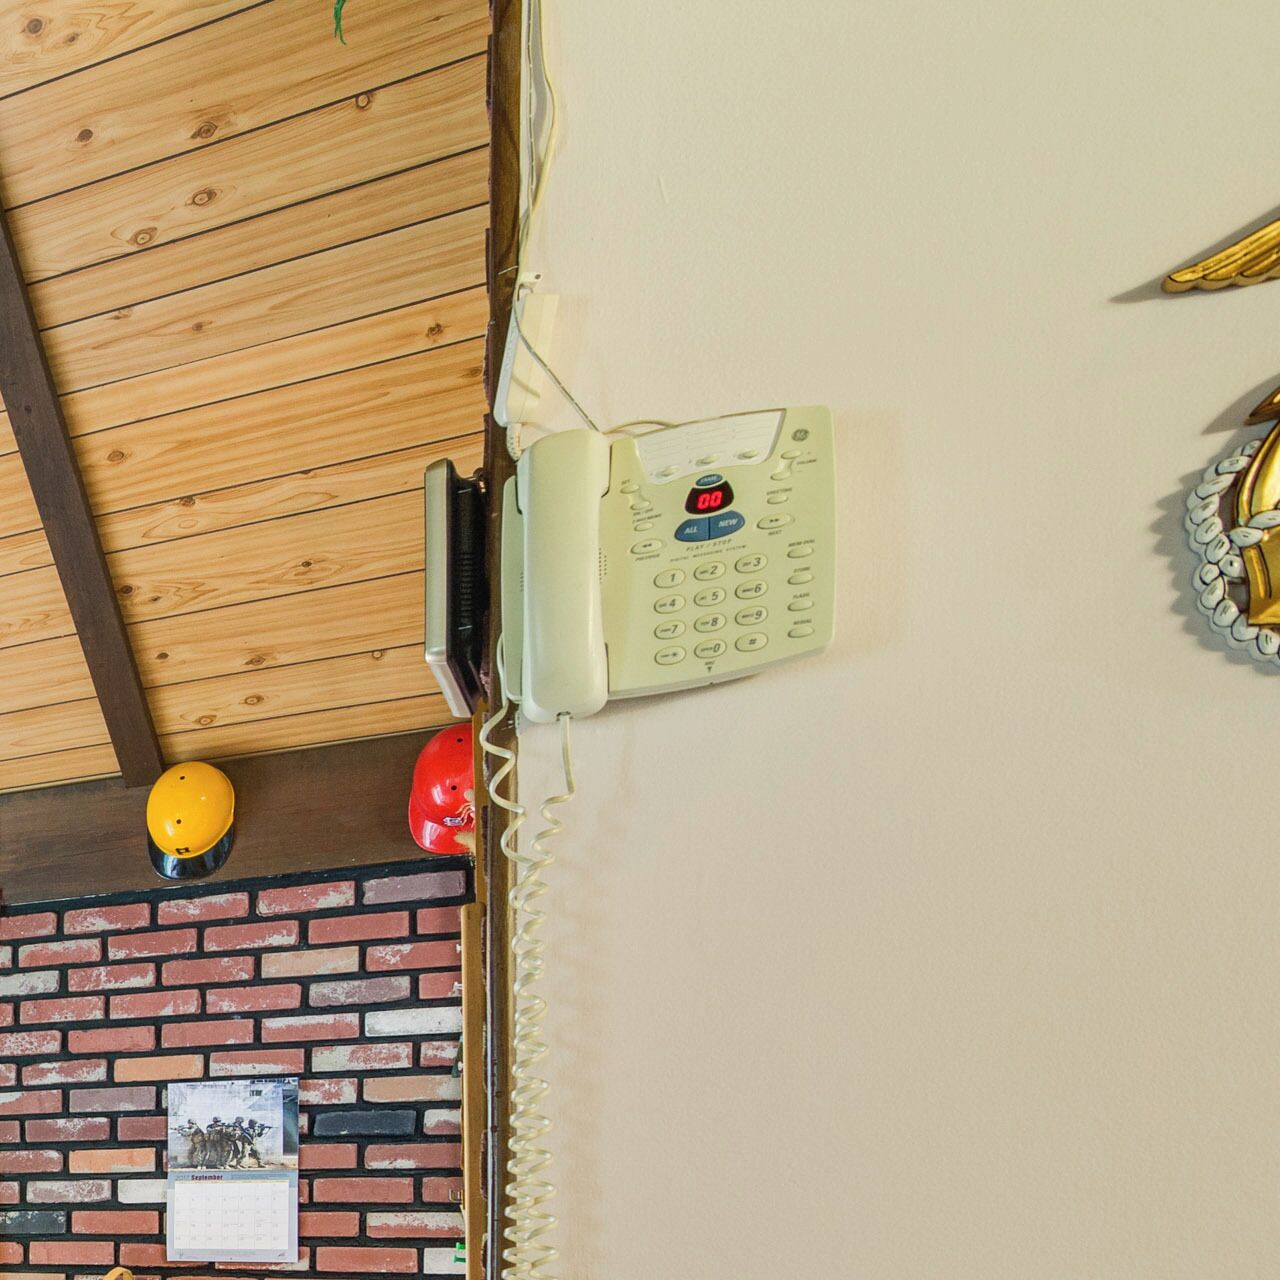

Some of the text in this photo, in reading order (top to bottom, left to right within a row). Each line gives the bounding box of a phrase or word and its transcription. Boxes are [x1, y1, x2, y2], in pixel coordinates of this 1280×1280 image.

[697, 490, 723, 510] 00
[718, 517, 739, 528] NEW
[684, 526, 698, 534] ALL
[686, 543, 704, 551] PLAY
[712, 538, 733, 547] STOP
[753, 557, 761, 567] 3
[710, 565, 718, 575] 2
[670, 573, 676, 582] 1
[754, 583, 762, 593] 6
[711, 591, 719, 601] 5
[669, 598, 676, 607] 4
[755, 610, 763, 620] 9
[710, 617, 719, 627] 8
[671, 624, 679, 634] 7
[713, 643, 721, 653] 0
